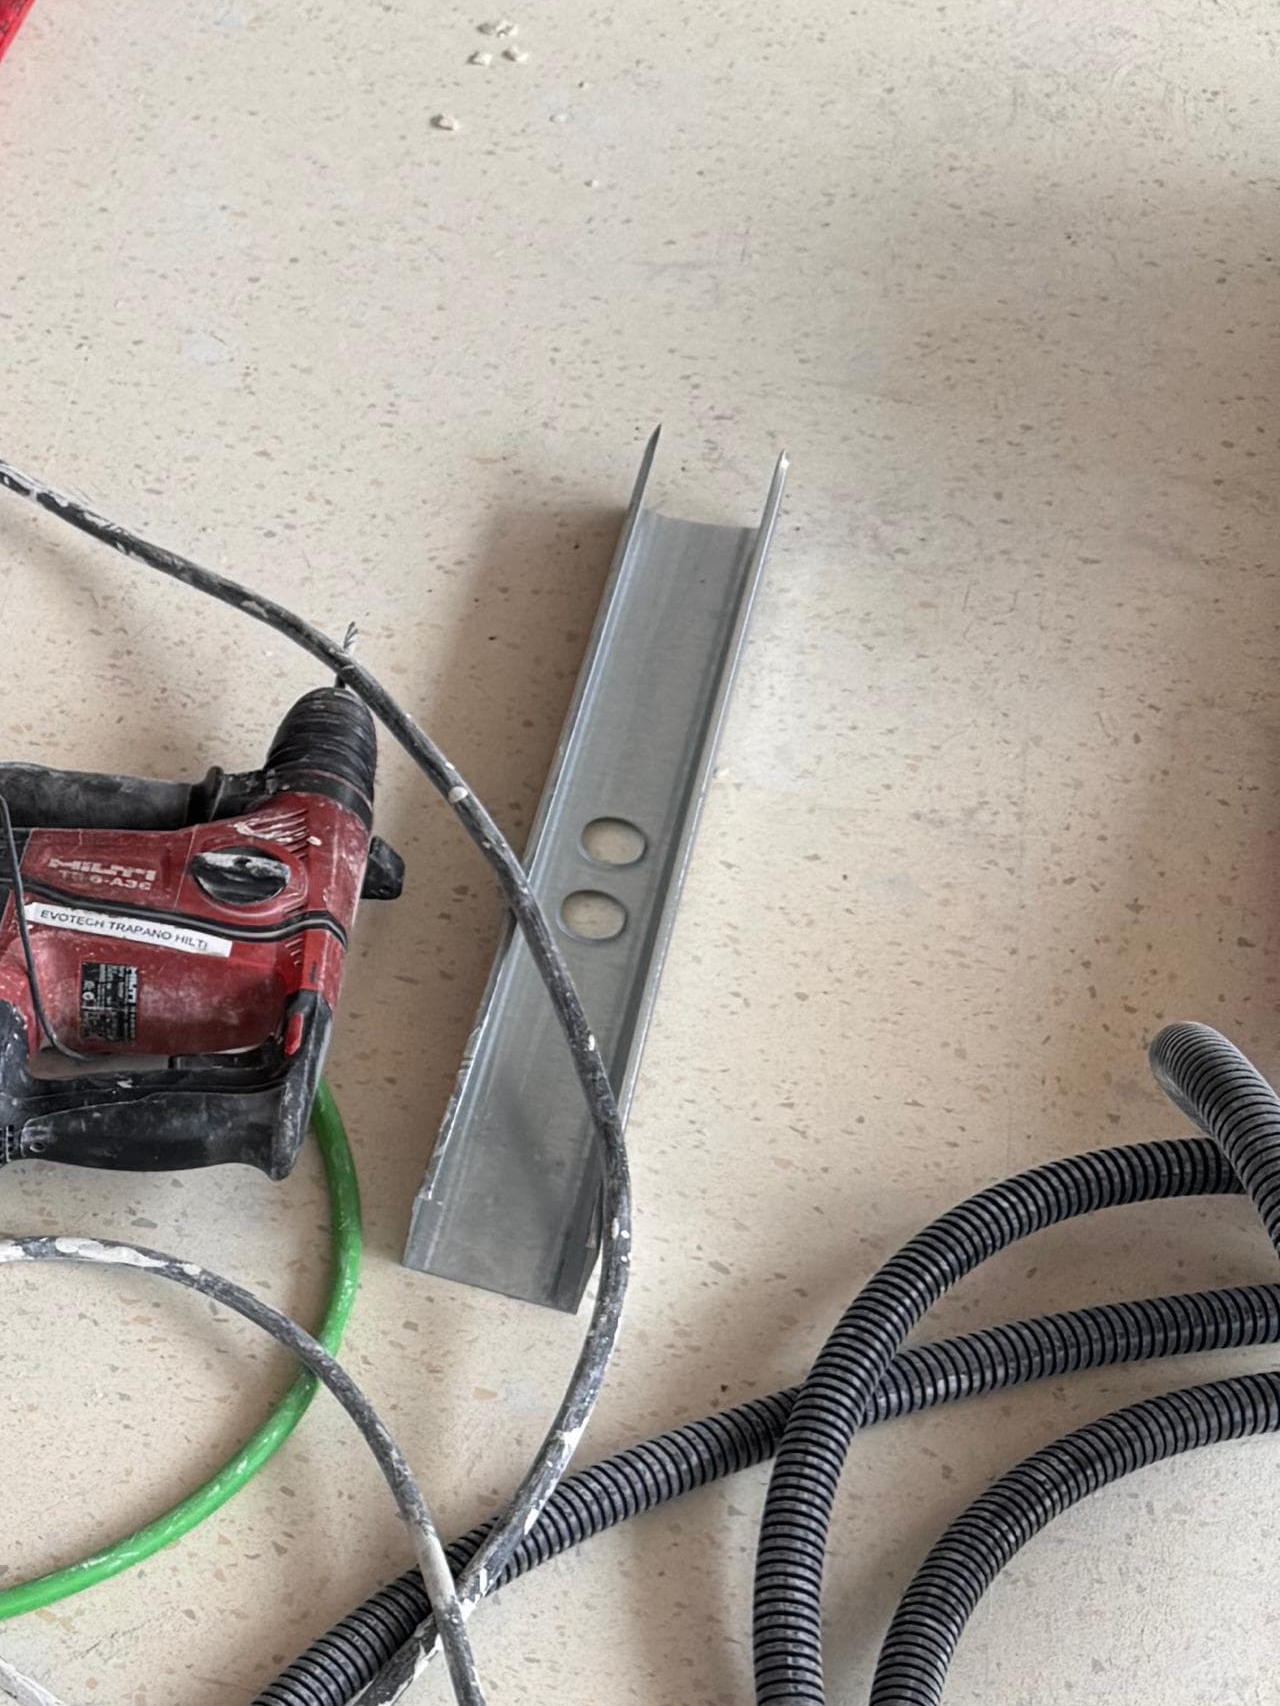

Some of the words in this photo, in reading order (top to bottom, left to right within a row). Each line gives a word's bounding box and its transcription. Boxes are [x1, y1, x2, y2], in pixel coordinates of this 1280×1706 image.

[48, 857, 157, 882] HILTI
[40, 908, 104, 929] EVOTECH
[109, 920, 172, 942] TRAPANO
[175, 933, 208, 951] HILTI
